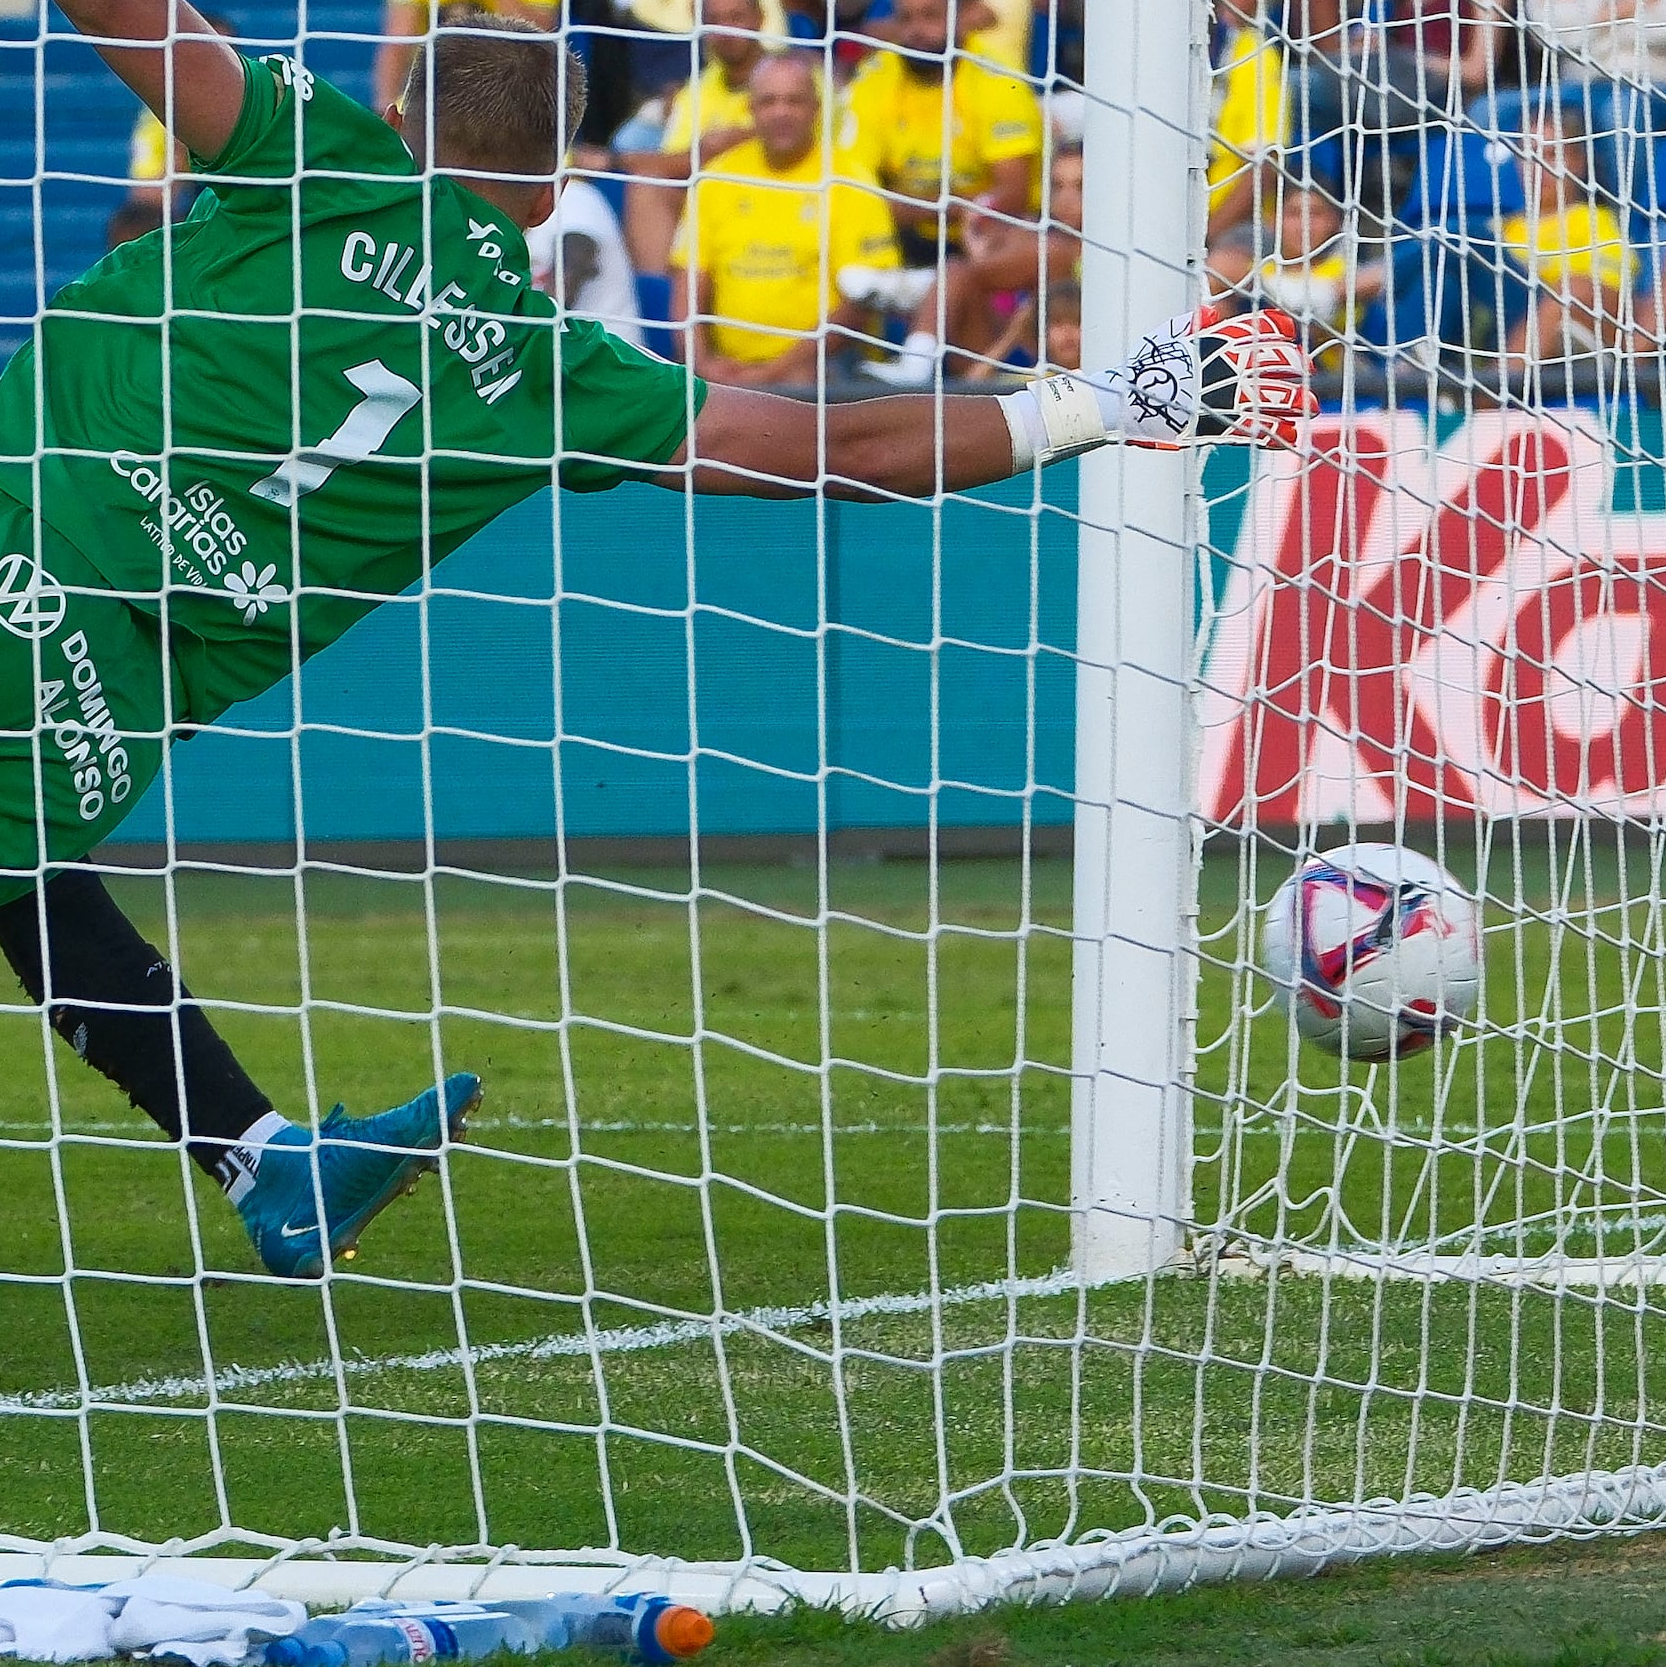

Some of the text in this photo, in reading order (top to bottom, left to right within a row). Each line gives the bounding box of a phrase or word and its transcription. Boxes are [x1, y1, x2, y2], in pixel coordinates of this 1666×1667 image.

[250, 358, 423, 507] 1
[183, 479, 248, 556] Islas
[37, 679, 105, 821] ALONSO
[60, 629, 132, 804] DOMINGO
